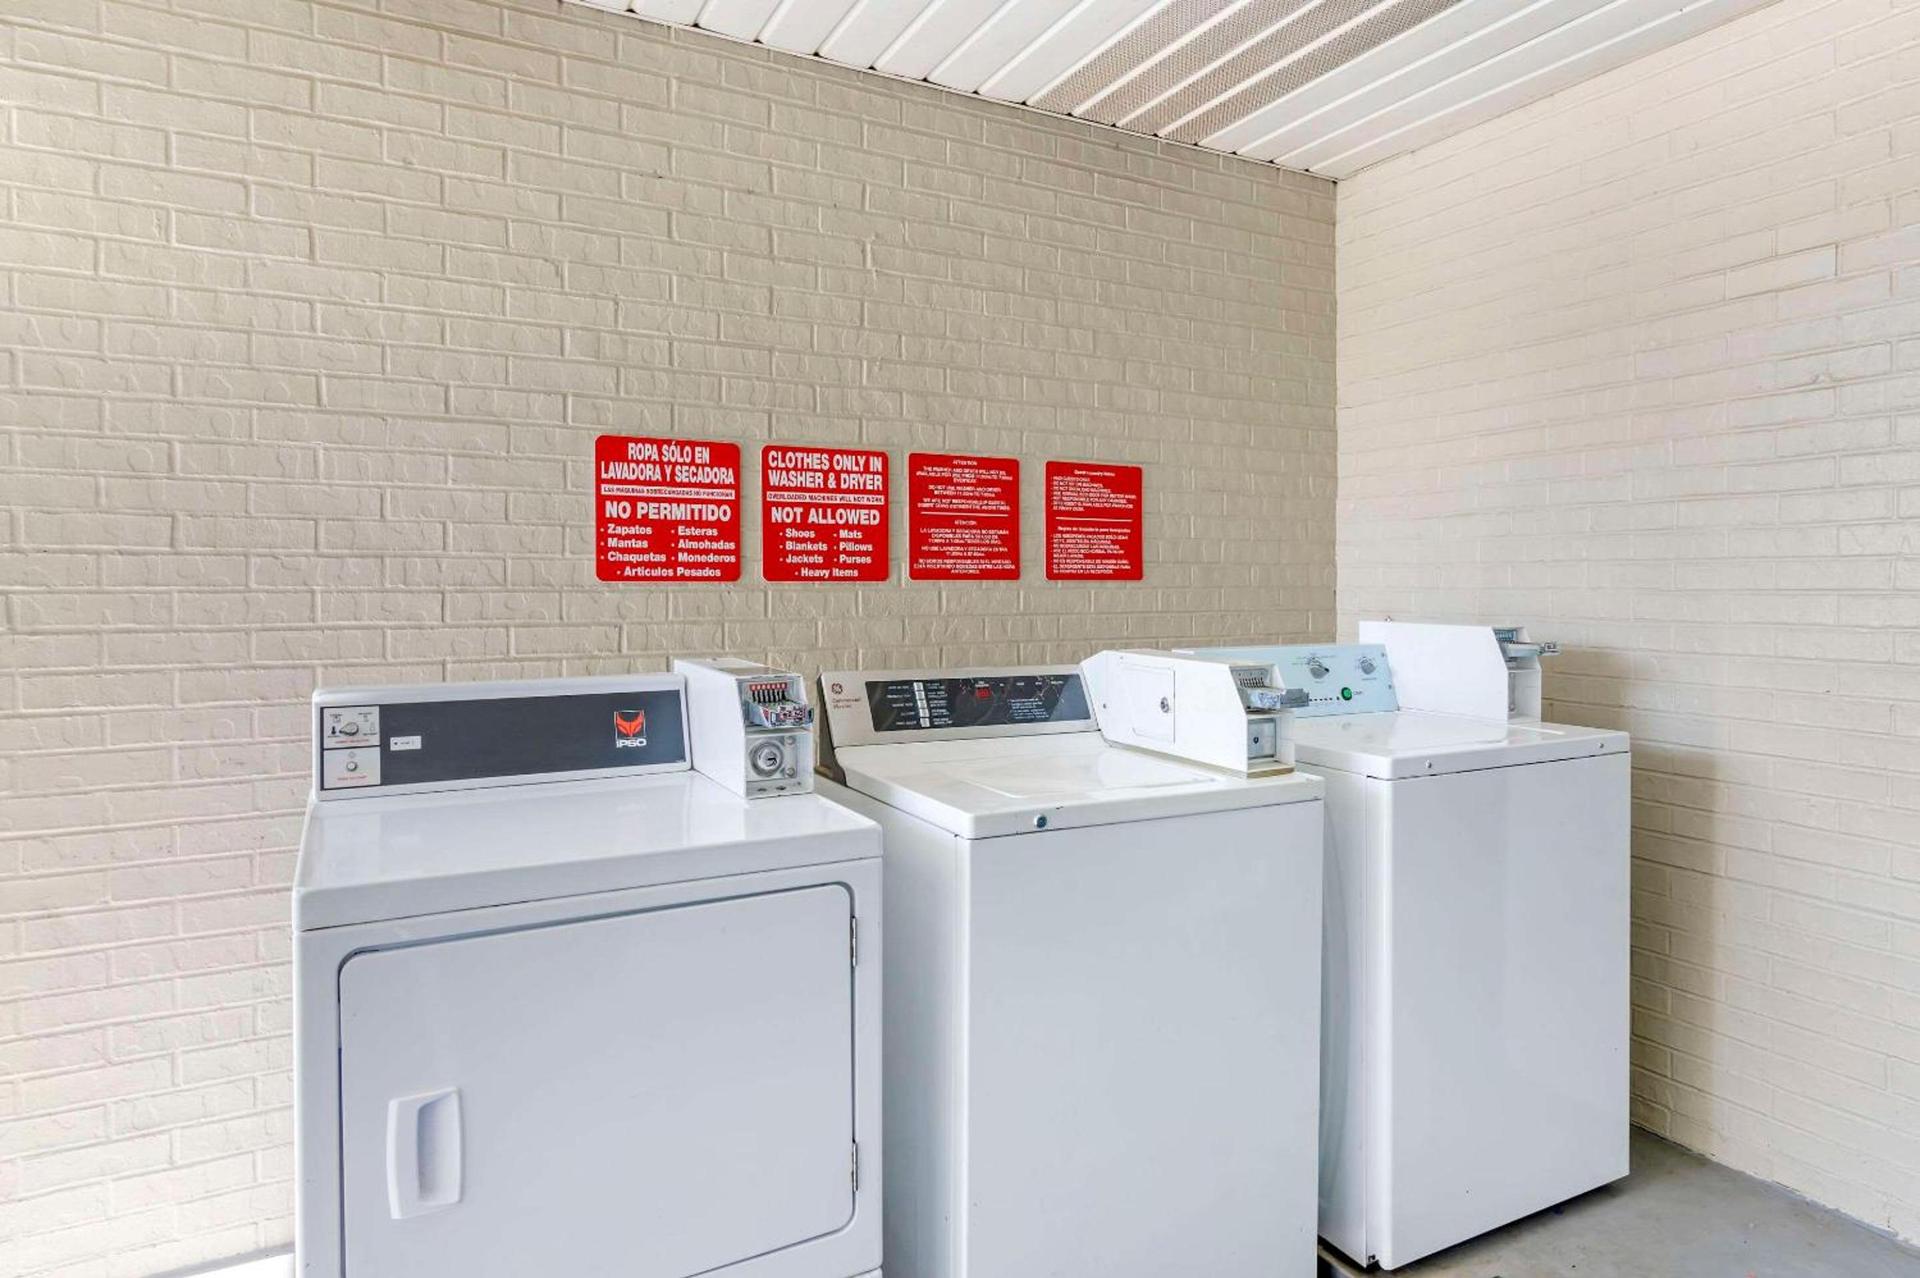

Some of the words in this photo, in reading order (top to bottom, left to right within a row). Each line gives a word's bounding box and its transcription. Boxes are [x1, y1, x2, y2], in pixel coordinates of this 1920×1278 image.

[628, 442, 660, 461] ROPA
[662, 441, 692, 463] SÓLO
[695, 446, 710, 464] EN
[768, 450, 830, 470] CLOTHES
[833, 454, 866, 472] ONLY
[870, 456, 882, 472] IN
[601, 461, 662, 481] LAVADORA
[664, 464, 673, 482] Y
[674, 466, 735, 484] SECADORA
[768, 470, 824, 488] WASHER
[828, 472, 836, 488] &
[840, 473, 882, 490] DRYER
[605, 501, 631, 519] NO
[636, 502, 731, 521] PERMITIDO
[771, 507, 803, 523] NOT
[808, 508, 880, 525] ALLOWED
[607, 524, 653, 535] Zapatos
[678, 526, 718, 536] Esteras
[785, 528, 816, 538] Shoes
[839, 530, 863, 538] Mats
[607, 538, 649, 548] Mantas
[678, 539, 736, 549] Almohadas
[785, 541, 828, 551] Blankets
[839, 542, 873, 551] Pillows
[607, 551, 667, 562] Chaquetas
[678, 552, 736, 562] Monederos
[785, 554, 824, 564] Jackets
[839, 554, 872, 564] Purses
[677, 567, 721, 577] Pesados
[801, 568, 830, 578] Heavy
[832, 568, 859, 577] Items
[616, 738, 647, 749] IPSO
